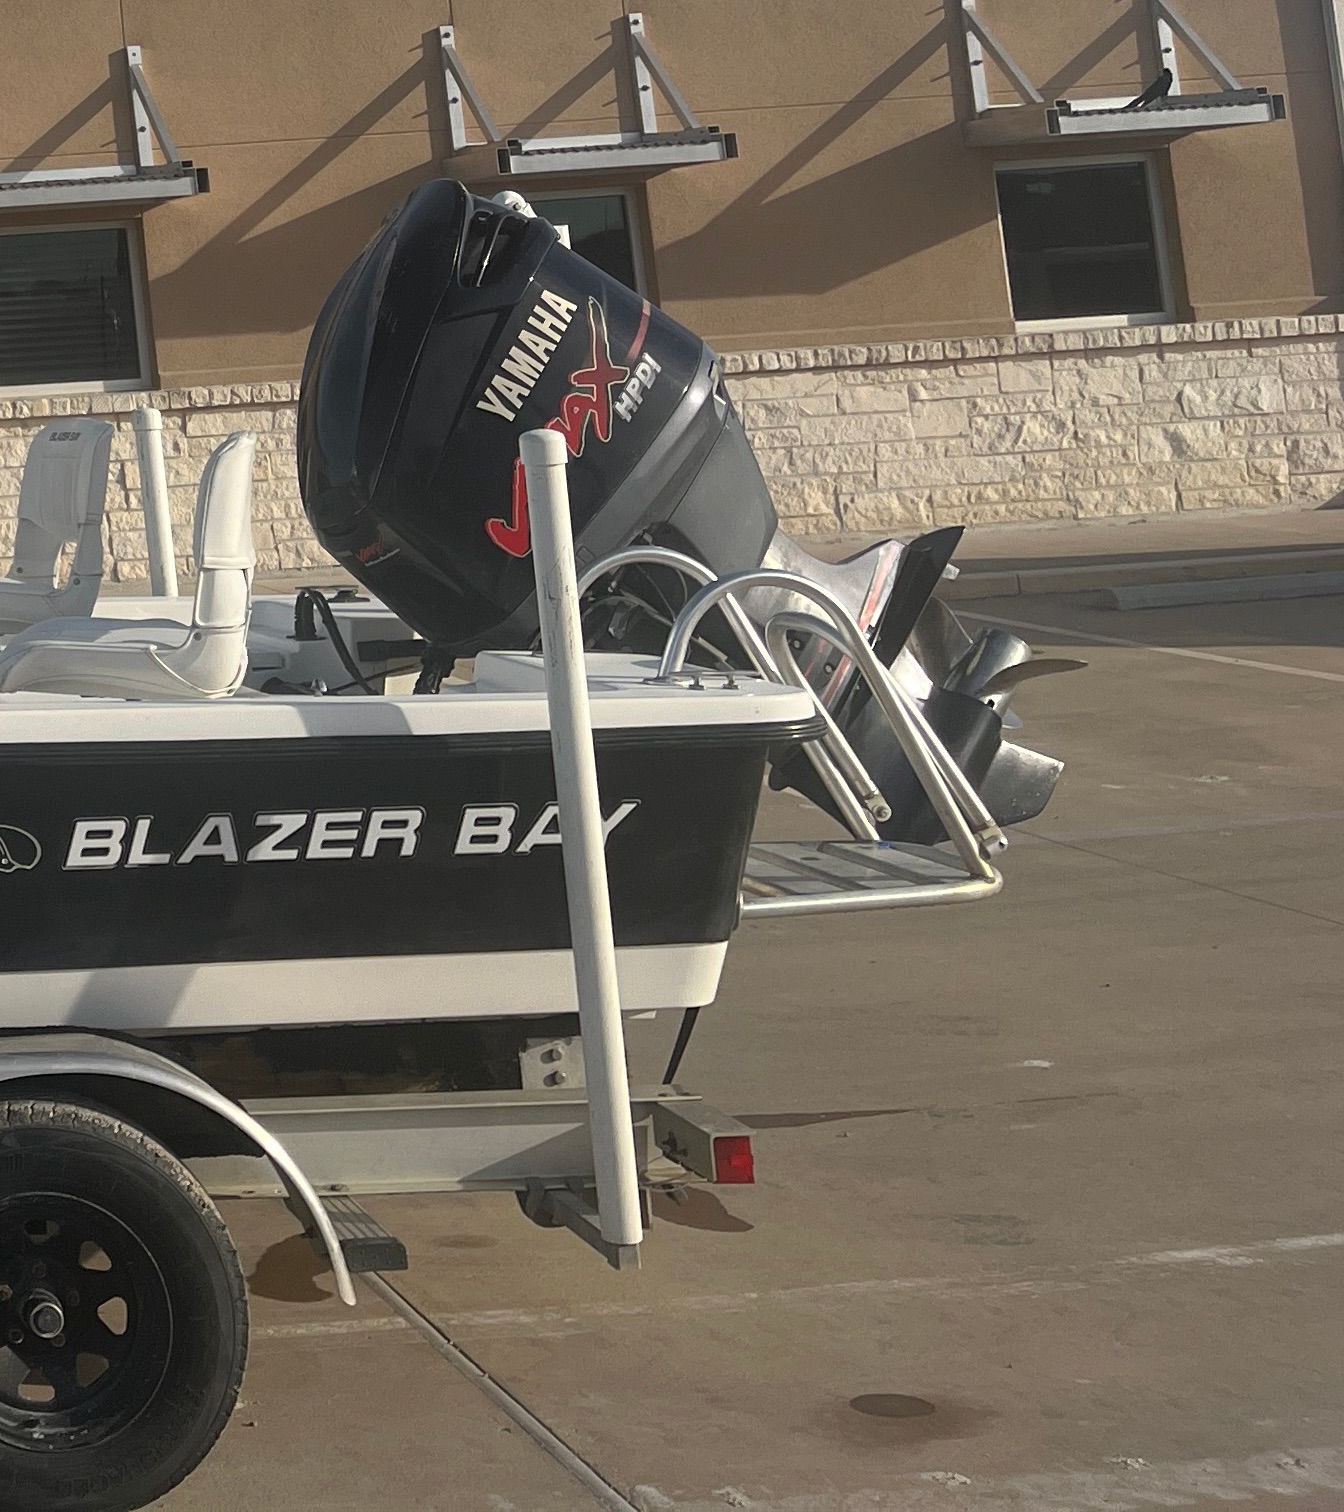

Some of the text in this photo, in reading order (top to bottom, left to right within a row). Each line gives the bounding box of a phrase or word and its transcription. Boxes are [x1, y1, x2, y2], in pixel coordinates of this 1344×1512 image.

[476, 289, 578, 423] YAMAHA
[613, 352, 662, 423] HPDI
[65, 807, 422, 869] BLAZER
